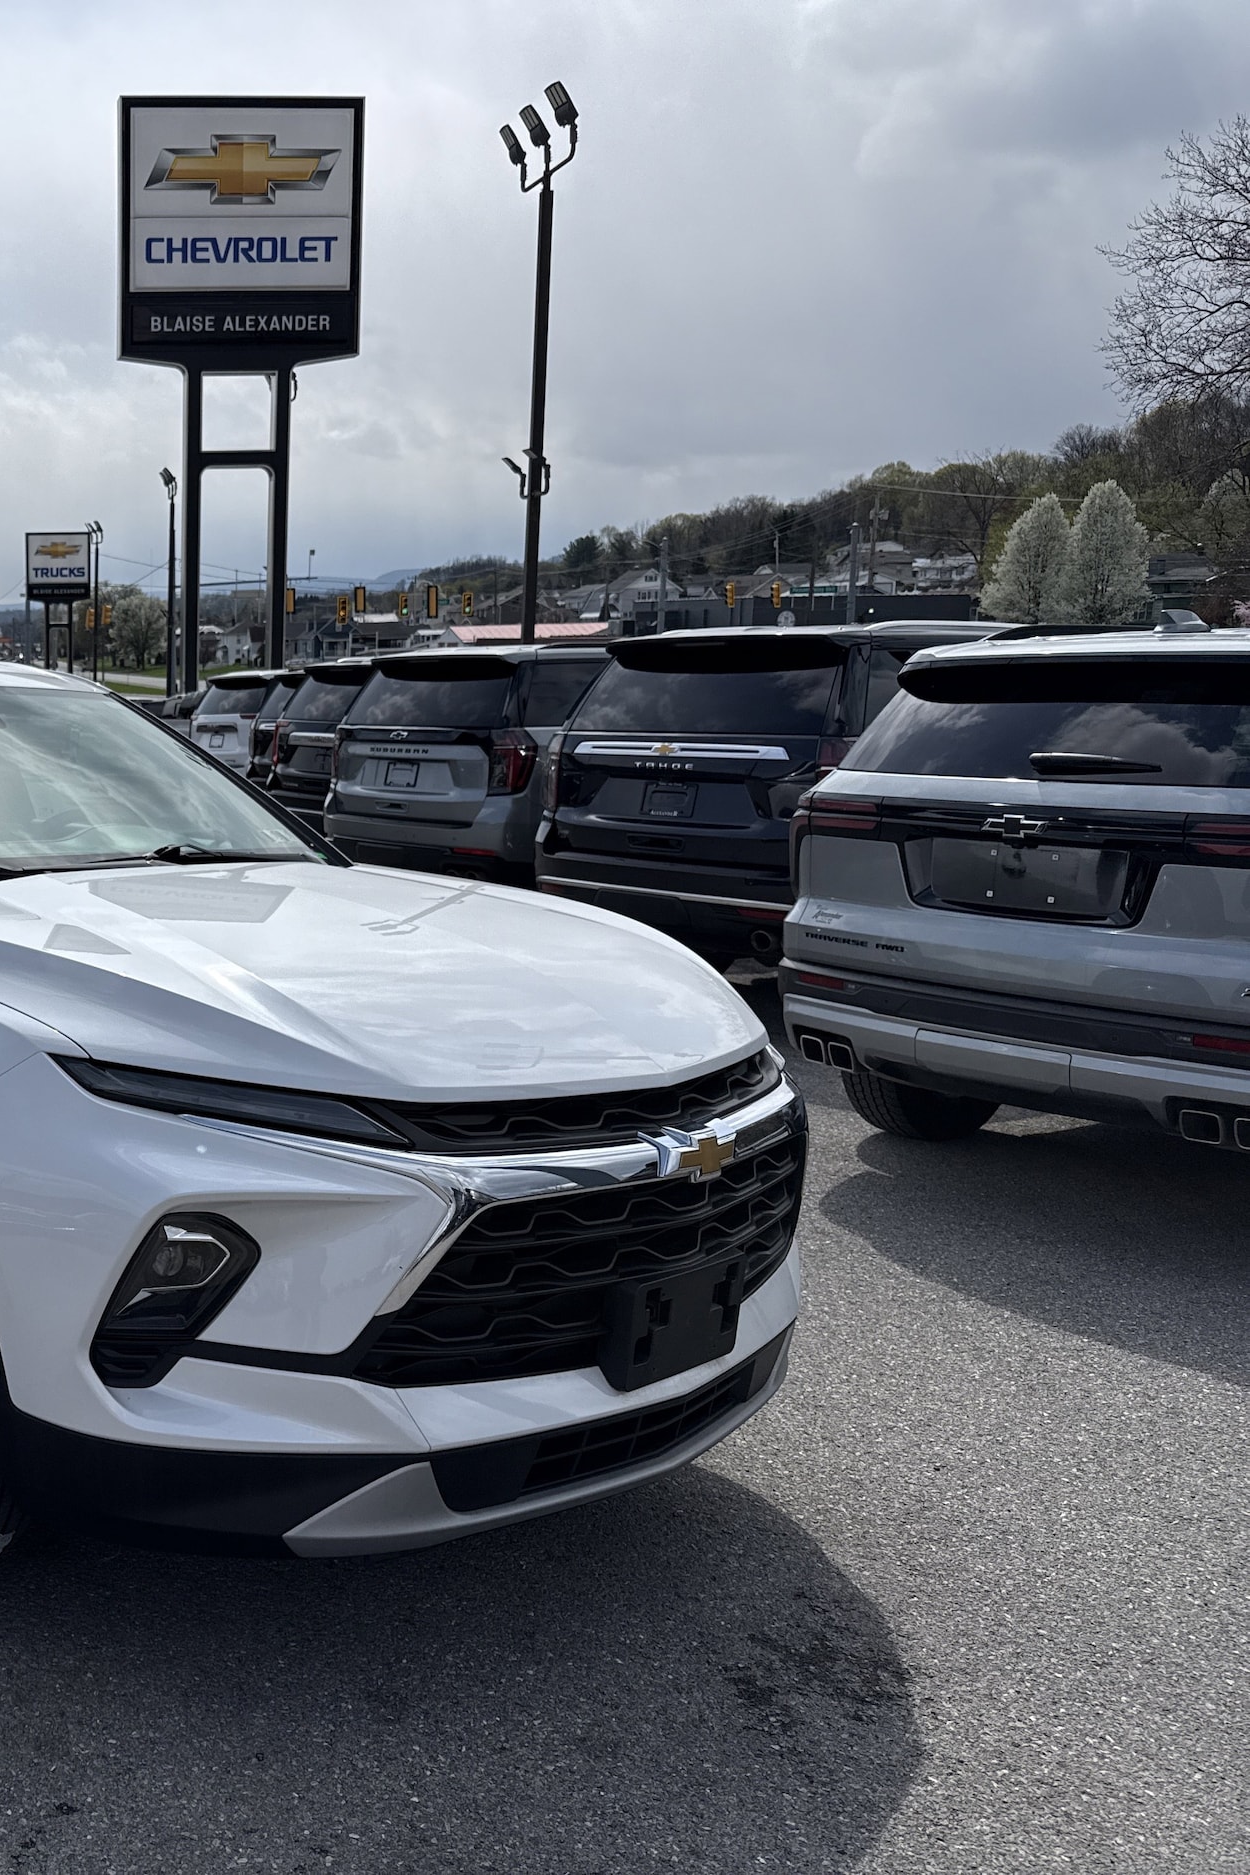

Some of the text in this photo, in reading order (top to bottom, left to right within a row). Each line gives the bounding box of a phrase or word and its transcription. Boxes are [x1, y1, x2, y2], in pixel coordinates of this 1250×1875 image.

[145, 236, 338, 264] CHEVROLET
[150, 315, 330, 332] BLAISE ALEXANDER
[32, 567, 86, 578] TRUCKS
[370, 747, 429, 755] SUBURBAN
[634, 761, 694, 771] TAHOE
[805, 932, 905, 953] TRAVERSE AWD
